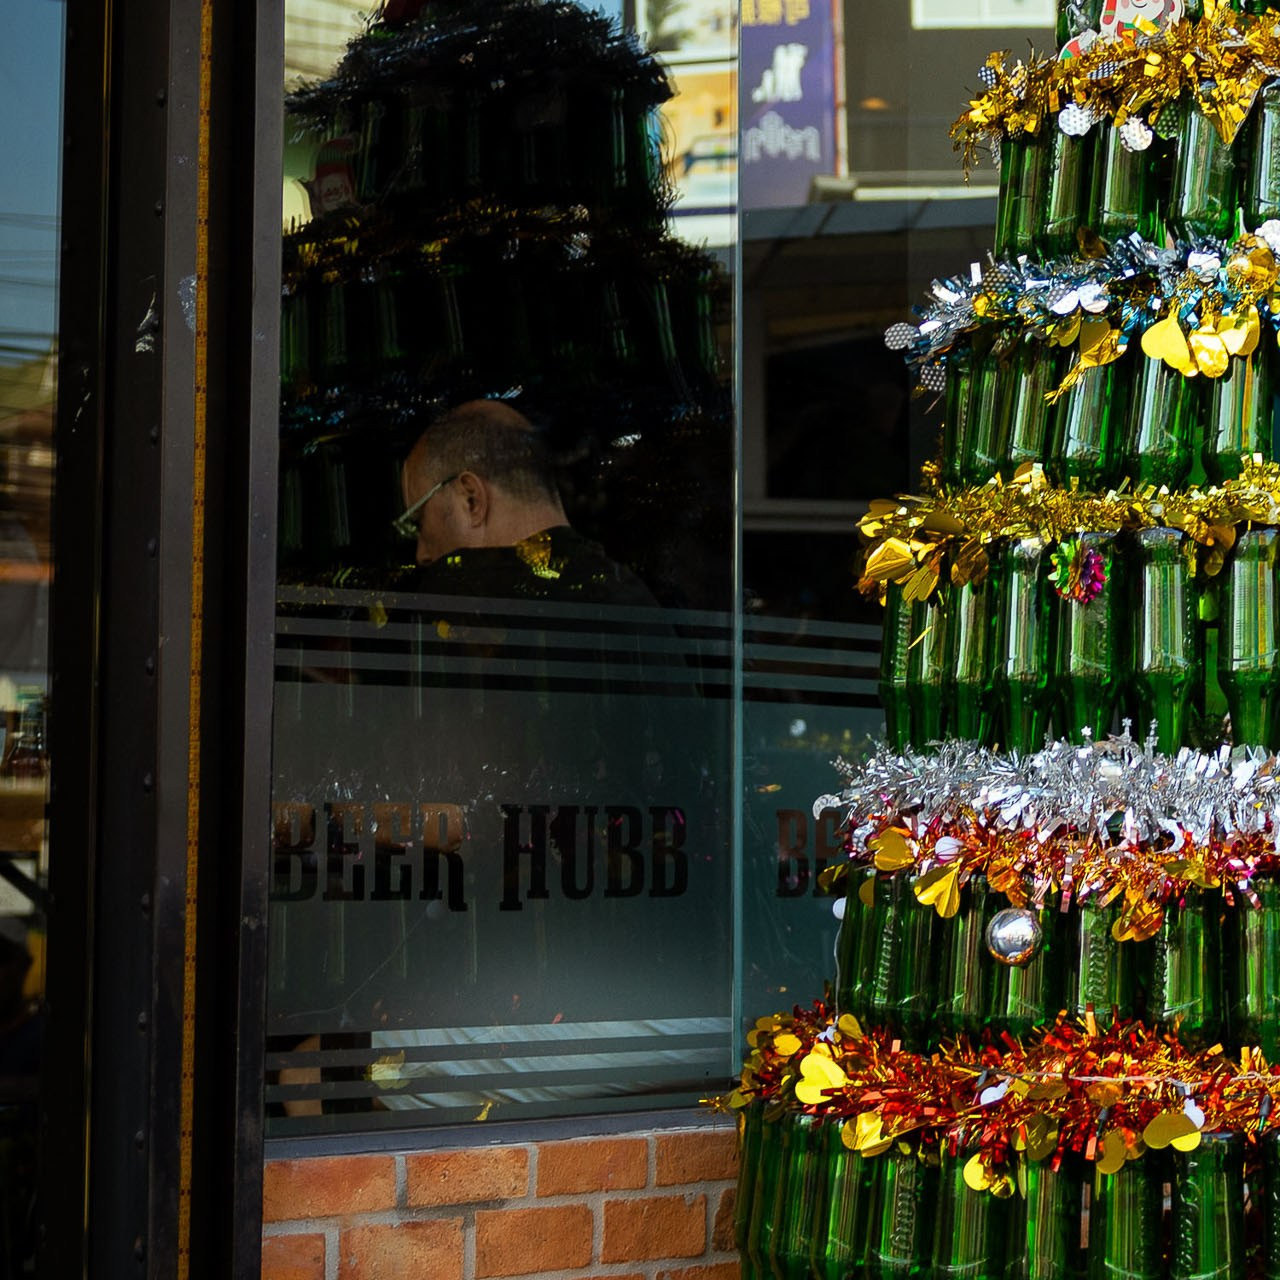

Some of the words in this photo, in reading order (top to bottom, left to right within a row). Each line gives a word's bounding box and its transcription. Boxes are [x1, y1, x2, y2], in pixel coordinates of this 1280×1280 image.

[270, 802, 468, 912] BEER
[499, 803, 690, 912] HUBB
[776, 809, 844, 898] BE
